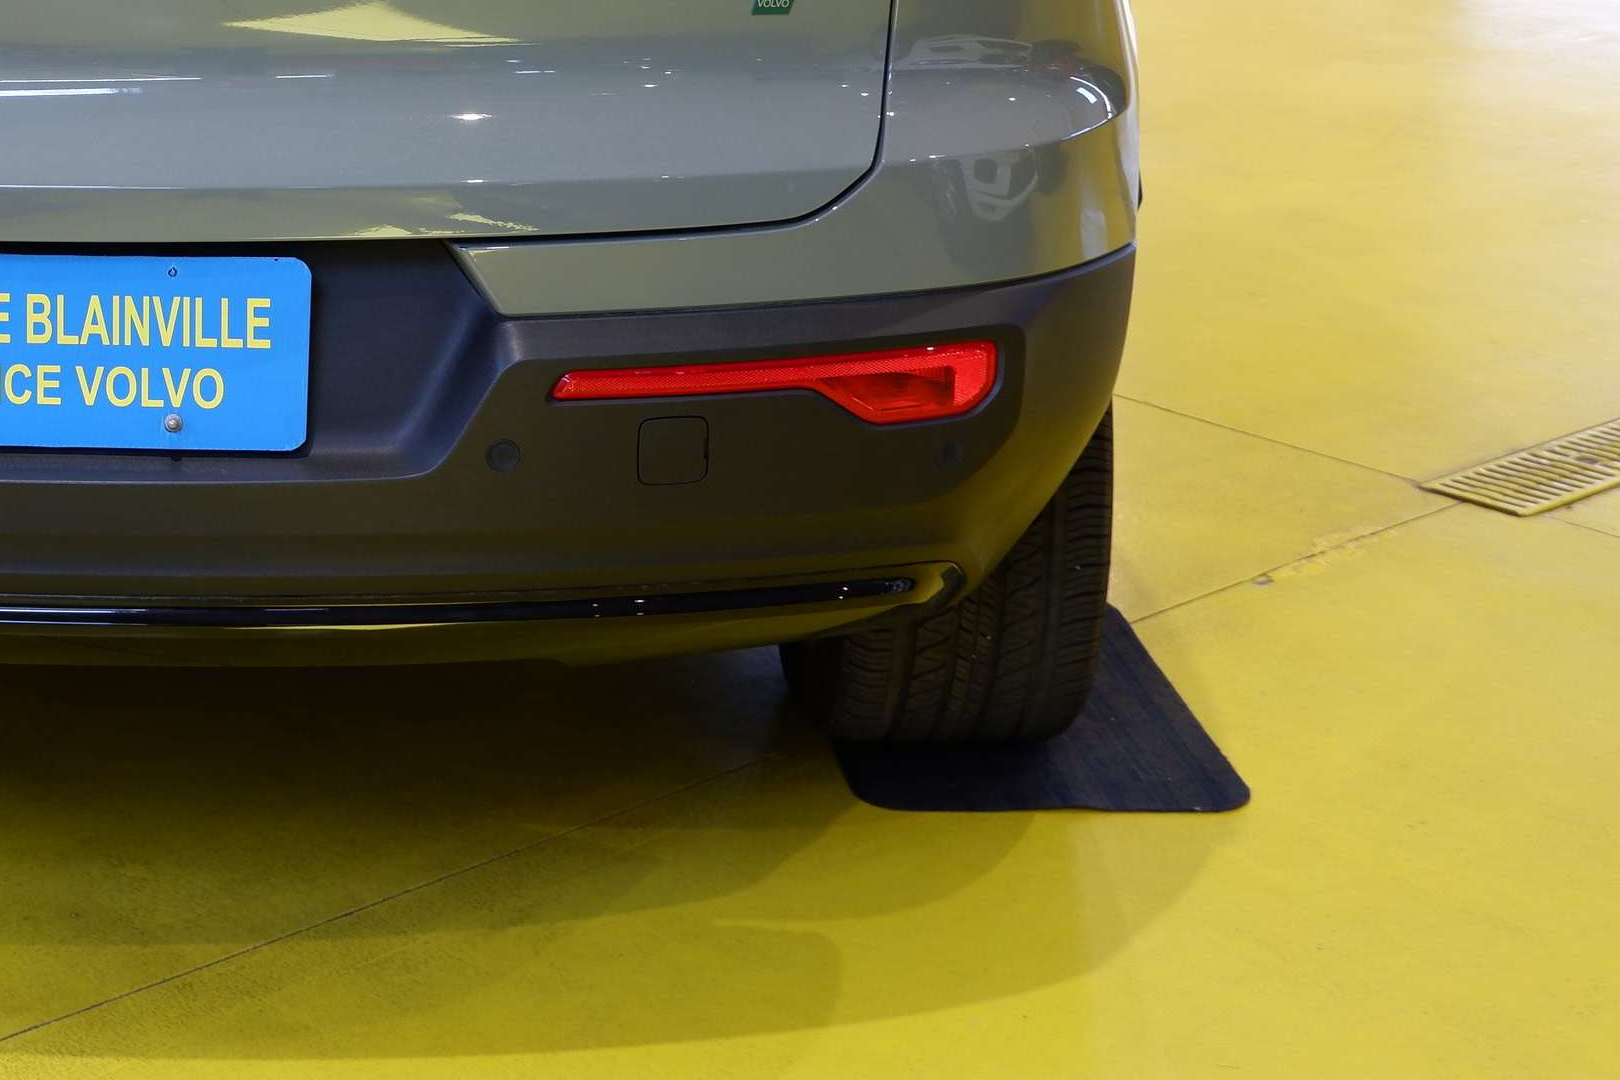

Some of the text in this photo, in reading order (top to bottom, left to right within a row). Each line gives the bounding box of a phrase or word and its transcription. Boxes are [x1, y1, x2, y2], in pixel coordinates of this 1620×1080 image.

[757, 0, 790, 8] VOLVO
[25, 293, 272, 349] BLAINVILLE
[75, 366, 225, 409] VOLVO
